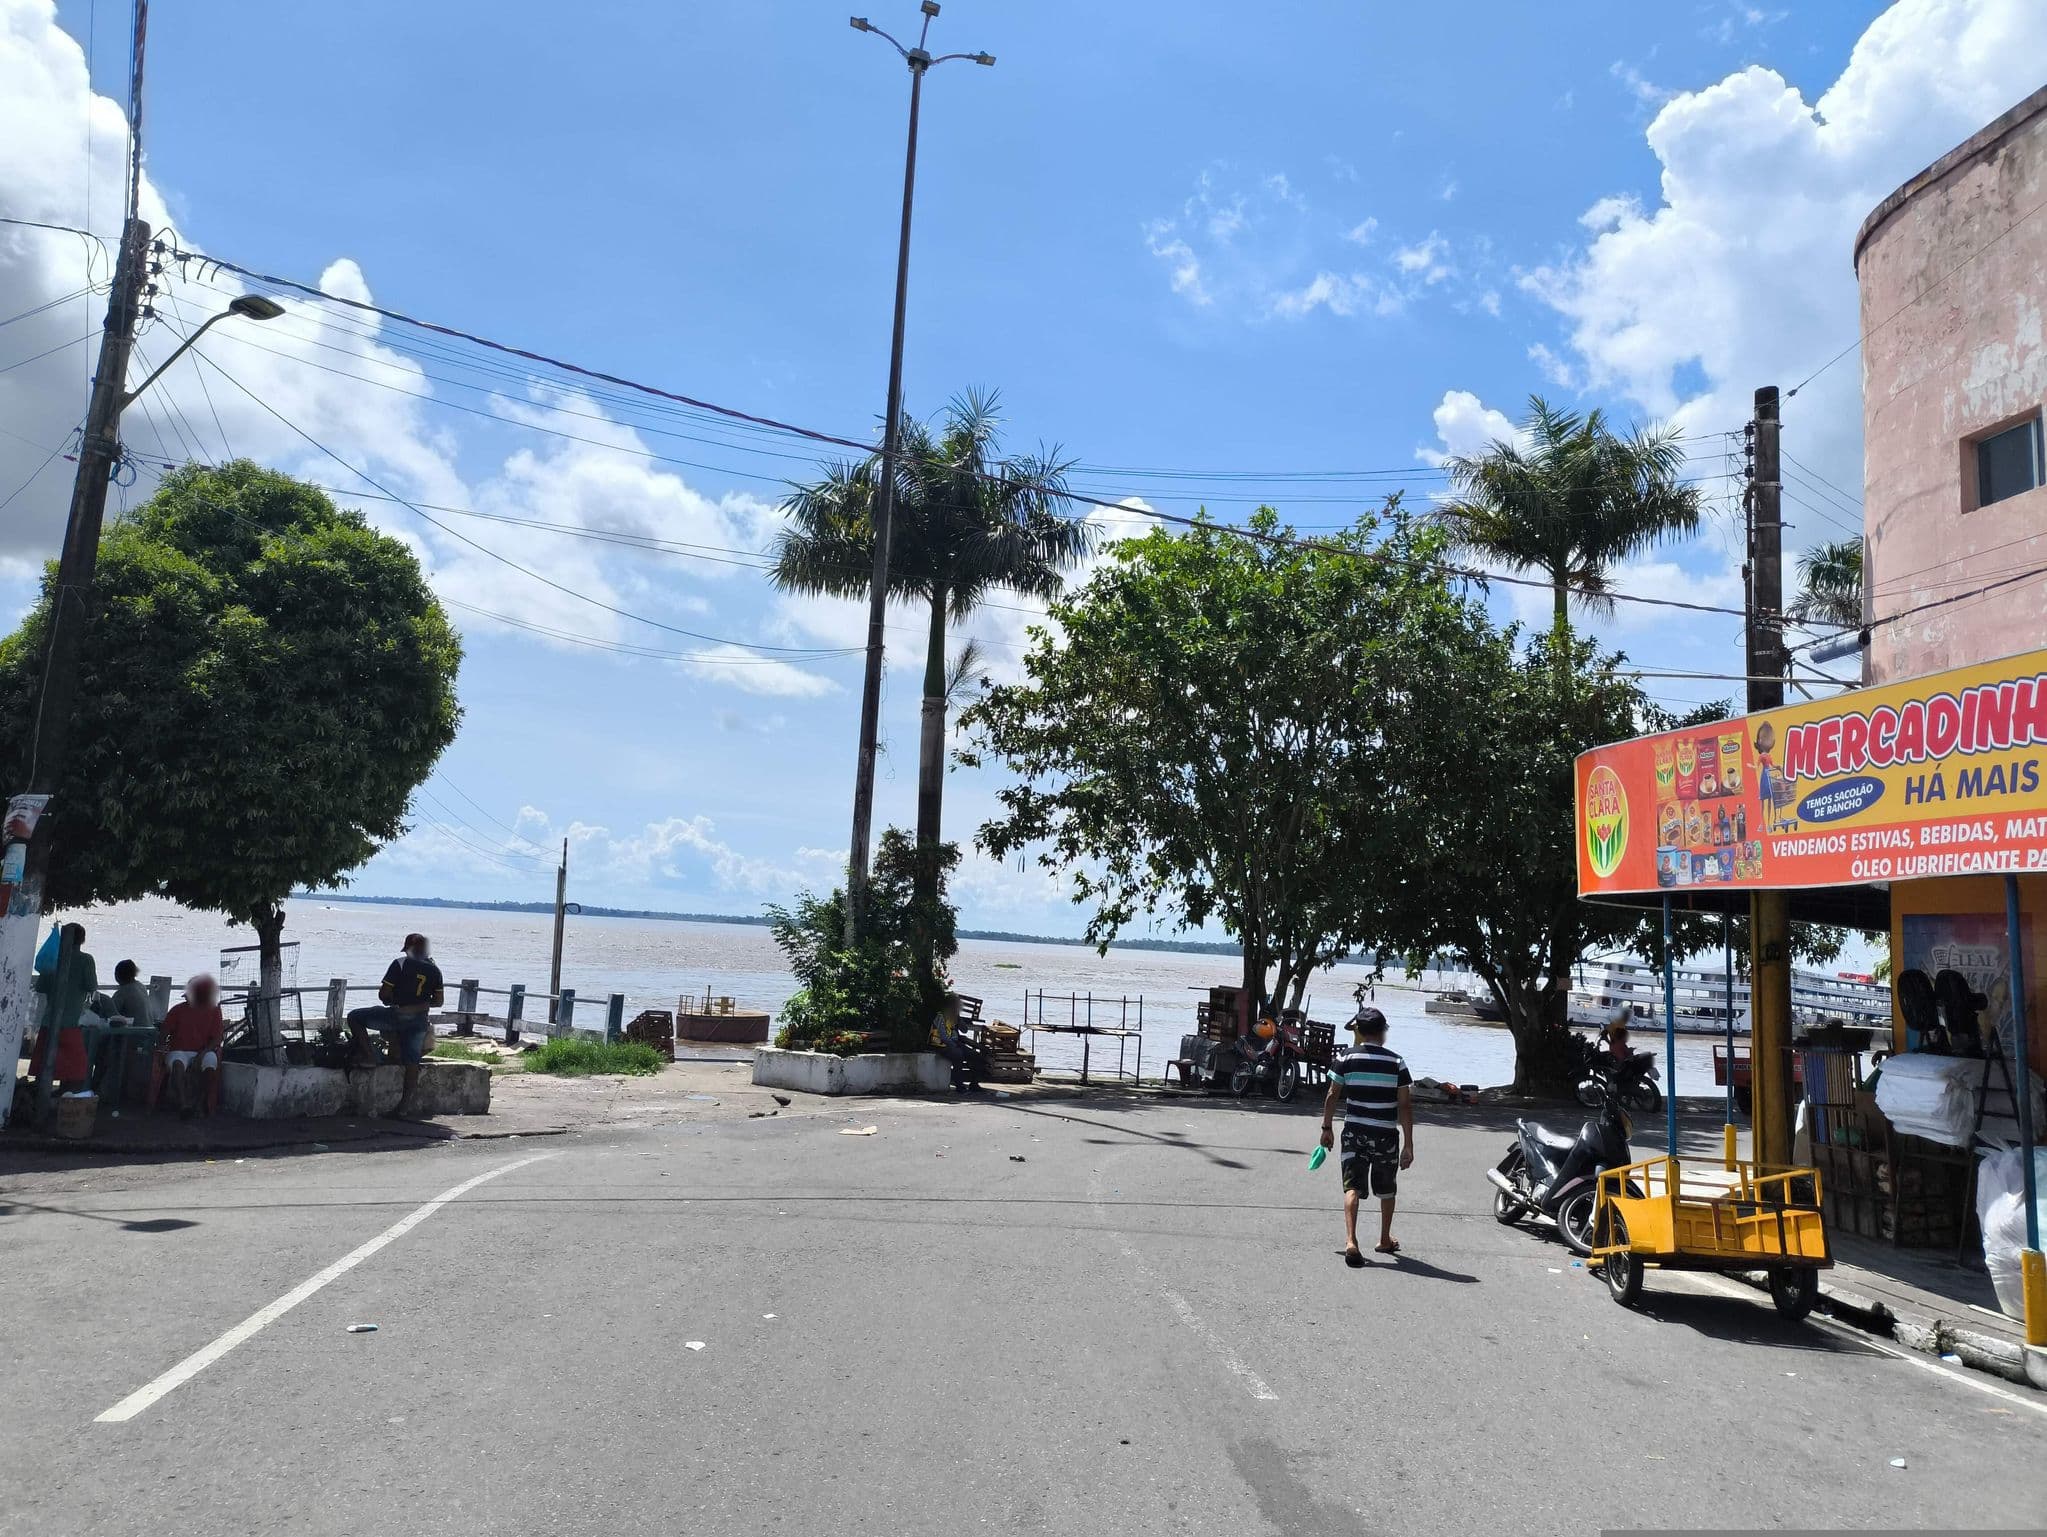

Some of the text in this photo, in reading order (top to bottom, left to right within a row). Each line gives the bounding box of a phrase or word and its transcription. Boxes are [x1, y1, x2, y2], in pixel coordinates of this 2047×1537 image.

[1784, 675, 2047, 780] MERCADINH
[1588, 780, 1616, 799] SANTA
[1904, 759, 2040, 805] HÁ MAIS
[1588, 797, 1621, 818] CLARA
[1805, 783, 1873, 810] TEMOS SACOLÃO
[1814, 797, 1863, 818] DE RANCHO
[1772, 817, 2047, 858] VENDEMOS ESTIVAS, BEBIDAS, MAT
[1851, 855, 1892, 878] ÓLEO
[1896, 849, 2020, 876] LUBRIFICANTE
[416, 974, 427, 997] 7
